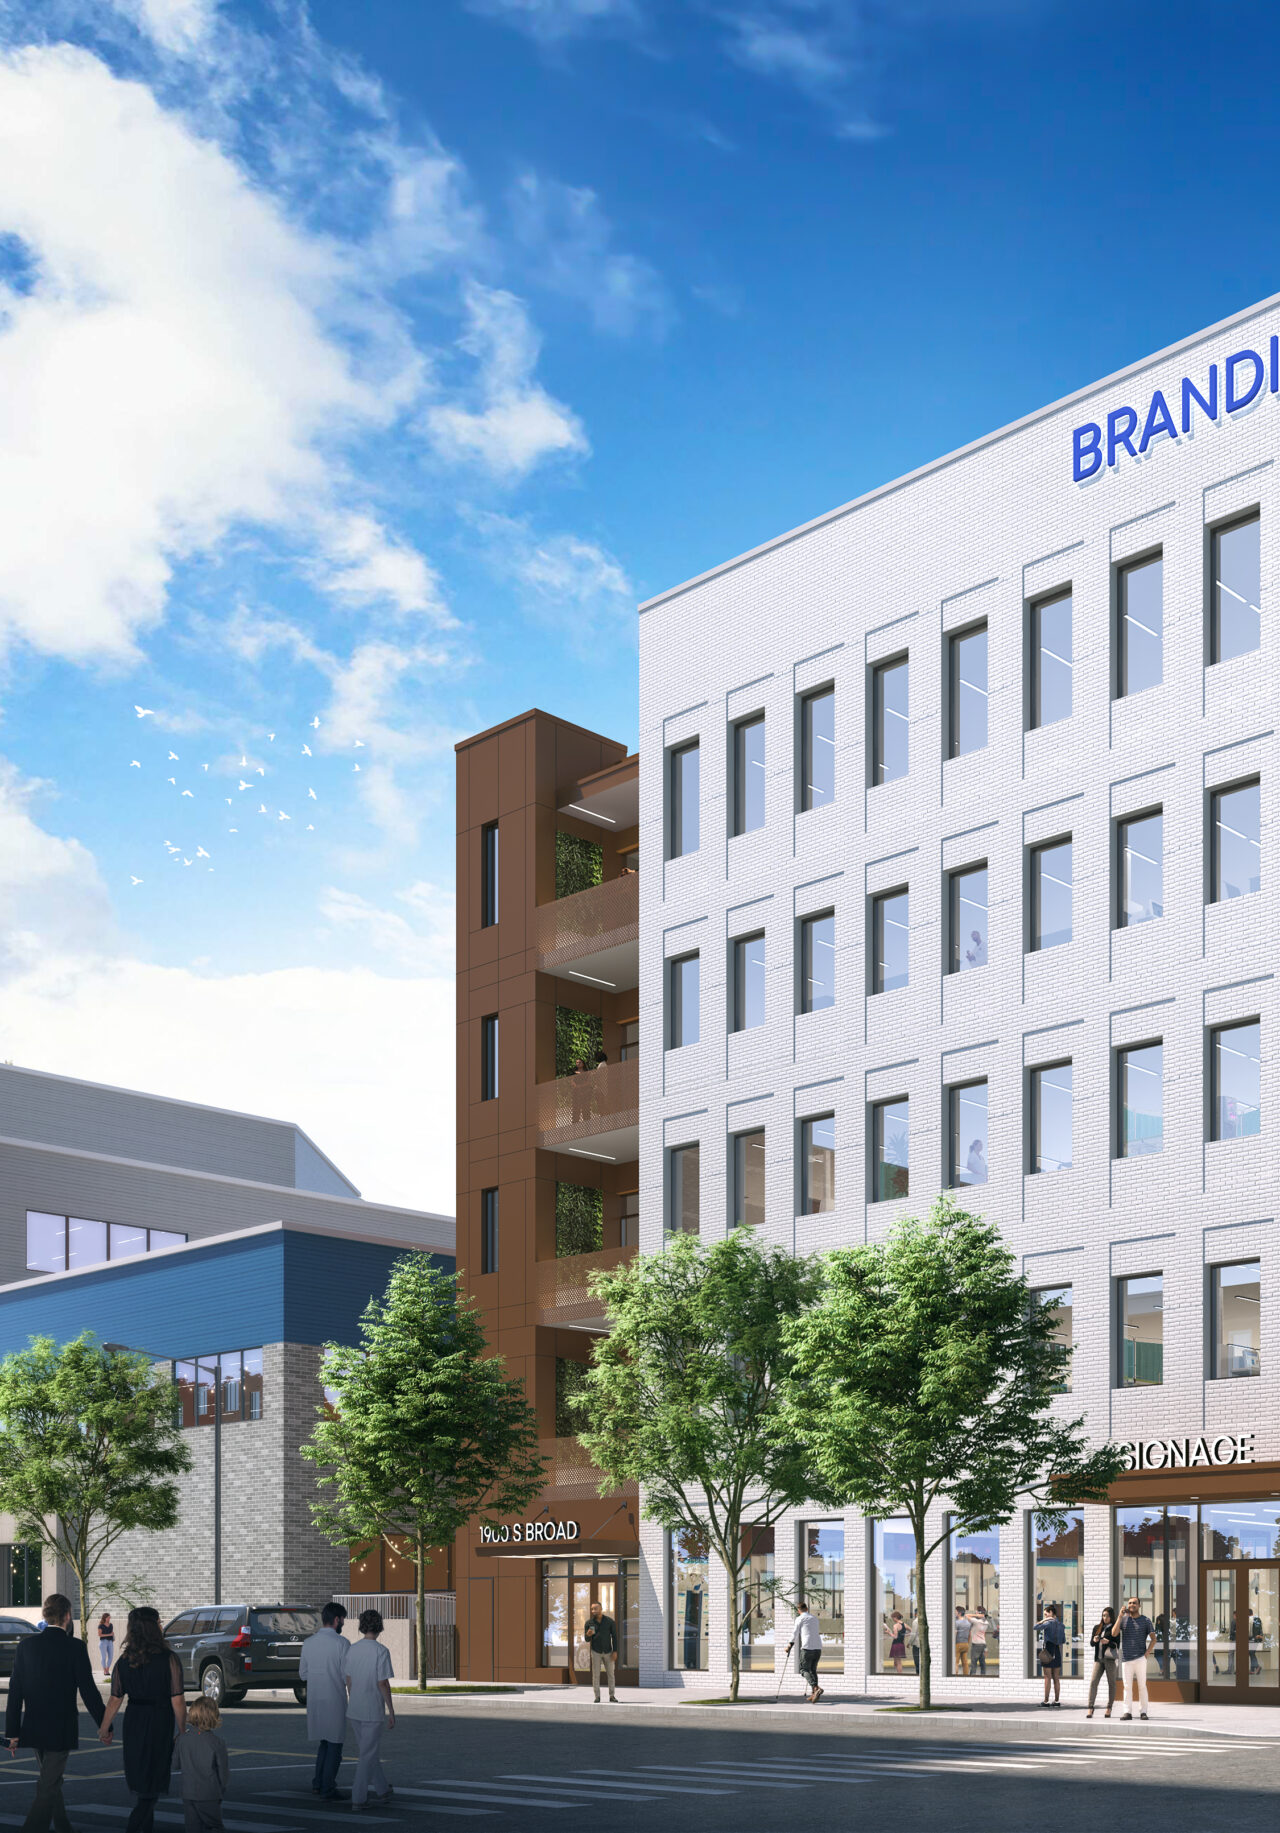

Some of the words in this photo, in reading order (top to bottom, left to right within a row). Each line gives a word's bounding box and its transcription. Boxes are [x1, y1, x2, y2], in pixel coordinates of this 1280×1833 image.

[1118, 1434, 1254, 1471] SIGNAGE
[513, 1523, 522, 1542] S
[525, 1520, 579, 1541] BROAD
